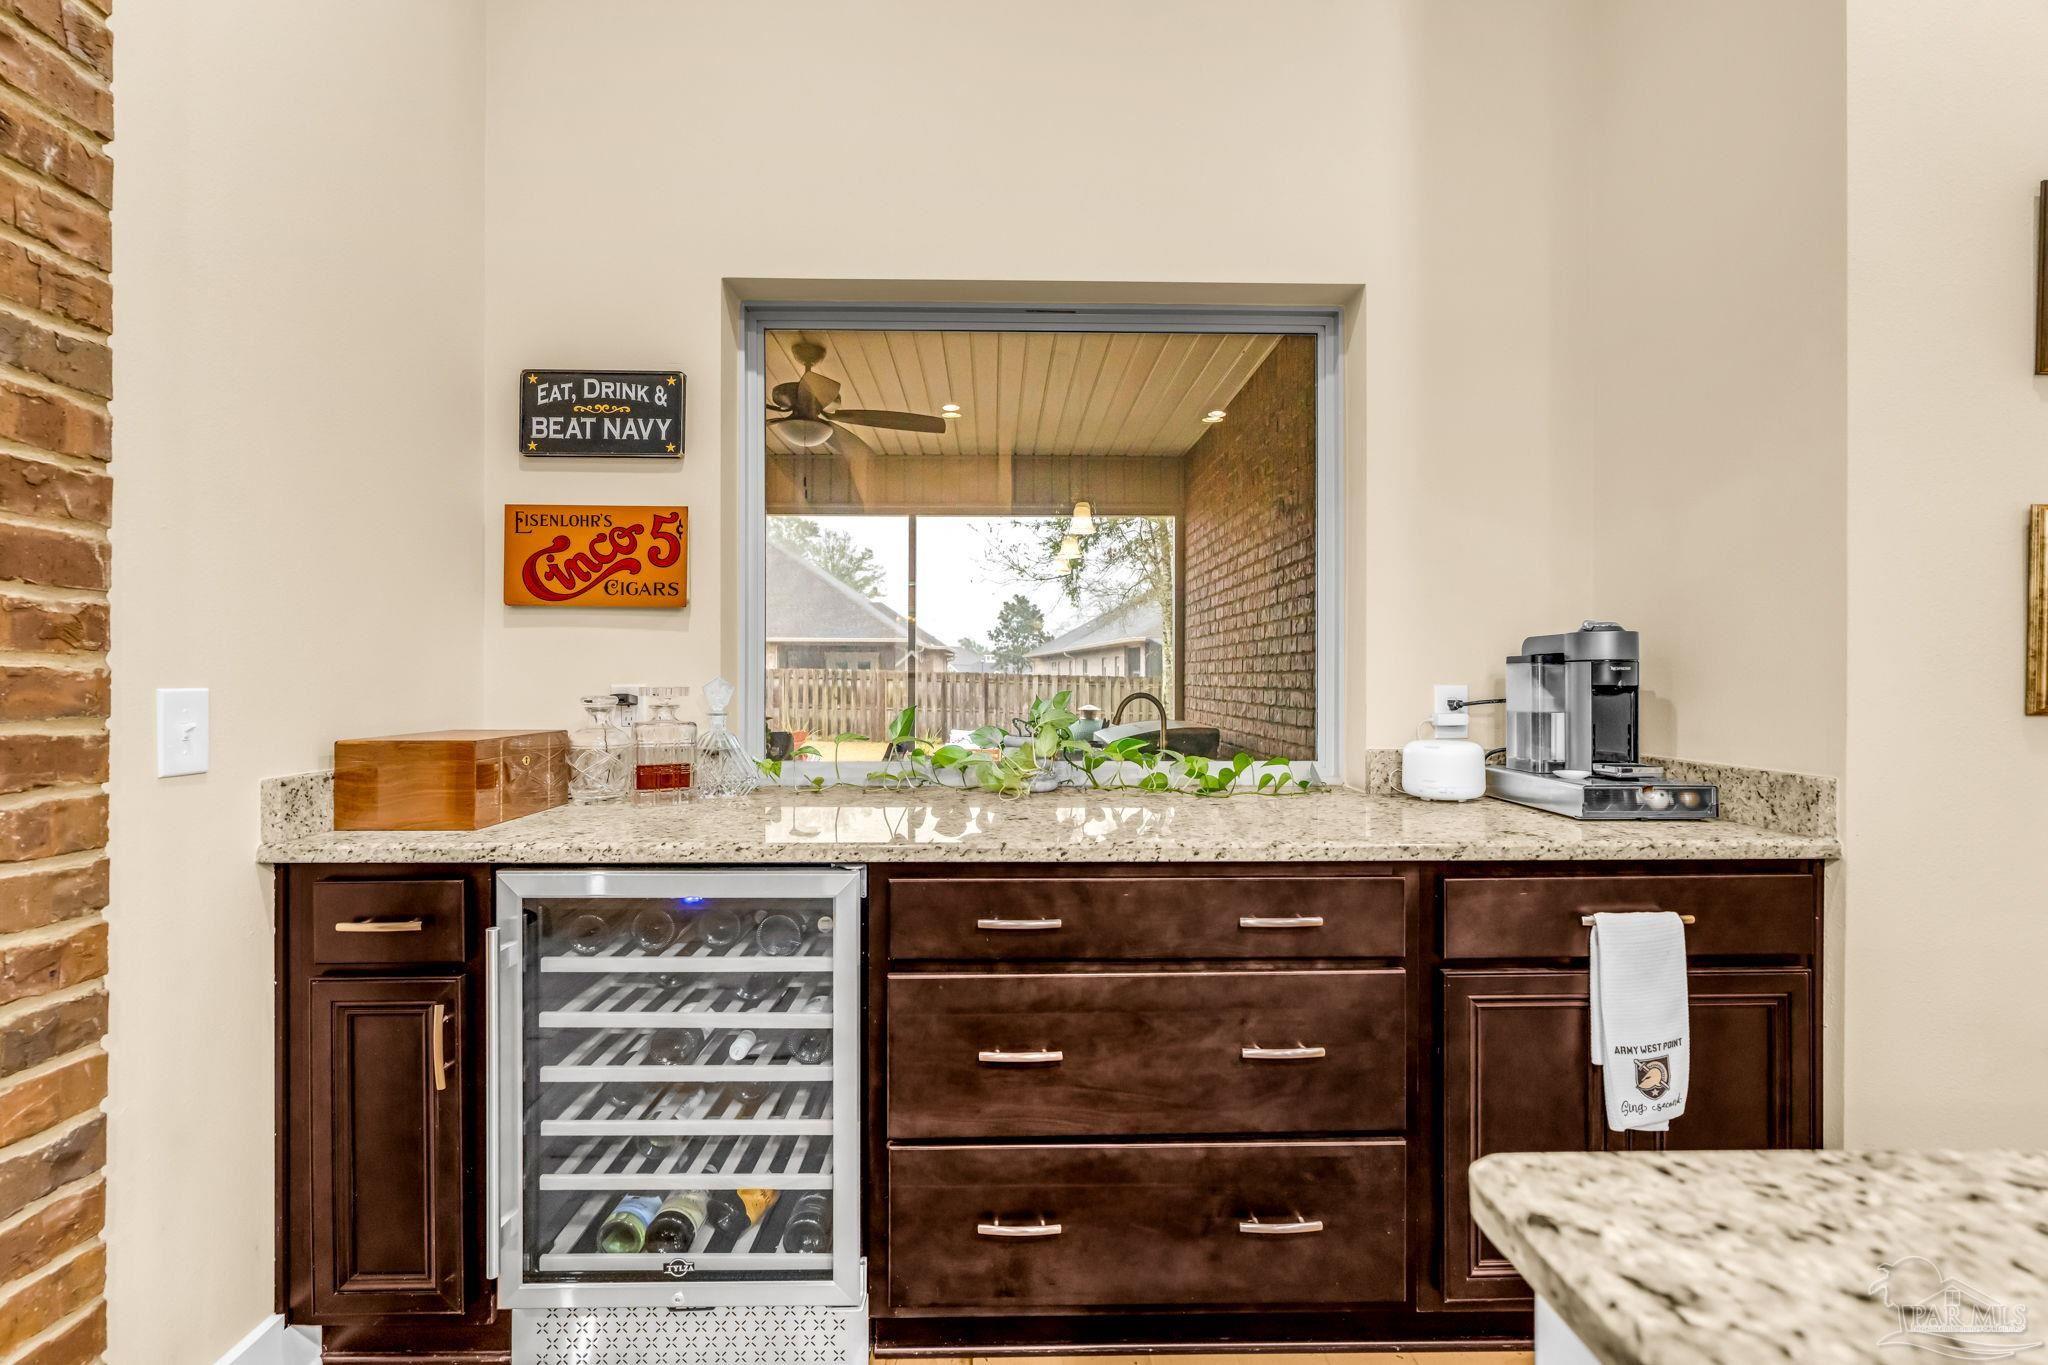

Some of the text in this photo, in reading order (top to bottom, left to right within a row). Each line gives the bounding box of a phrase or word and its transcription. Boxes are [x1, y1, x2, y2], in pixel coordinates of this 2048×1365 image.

[537, 378, 667, 407] EAT, DRINK &
[531, 416, 672, 441] BEAT NAVY
[515, 511, 613, 533] EISENLOHR'S
[522, 523, 645, 602] Cinco
[603, 579, 680, 597] CIGARS
[1614, 1037, 1682, 1055] ARMY WEST POINT
